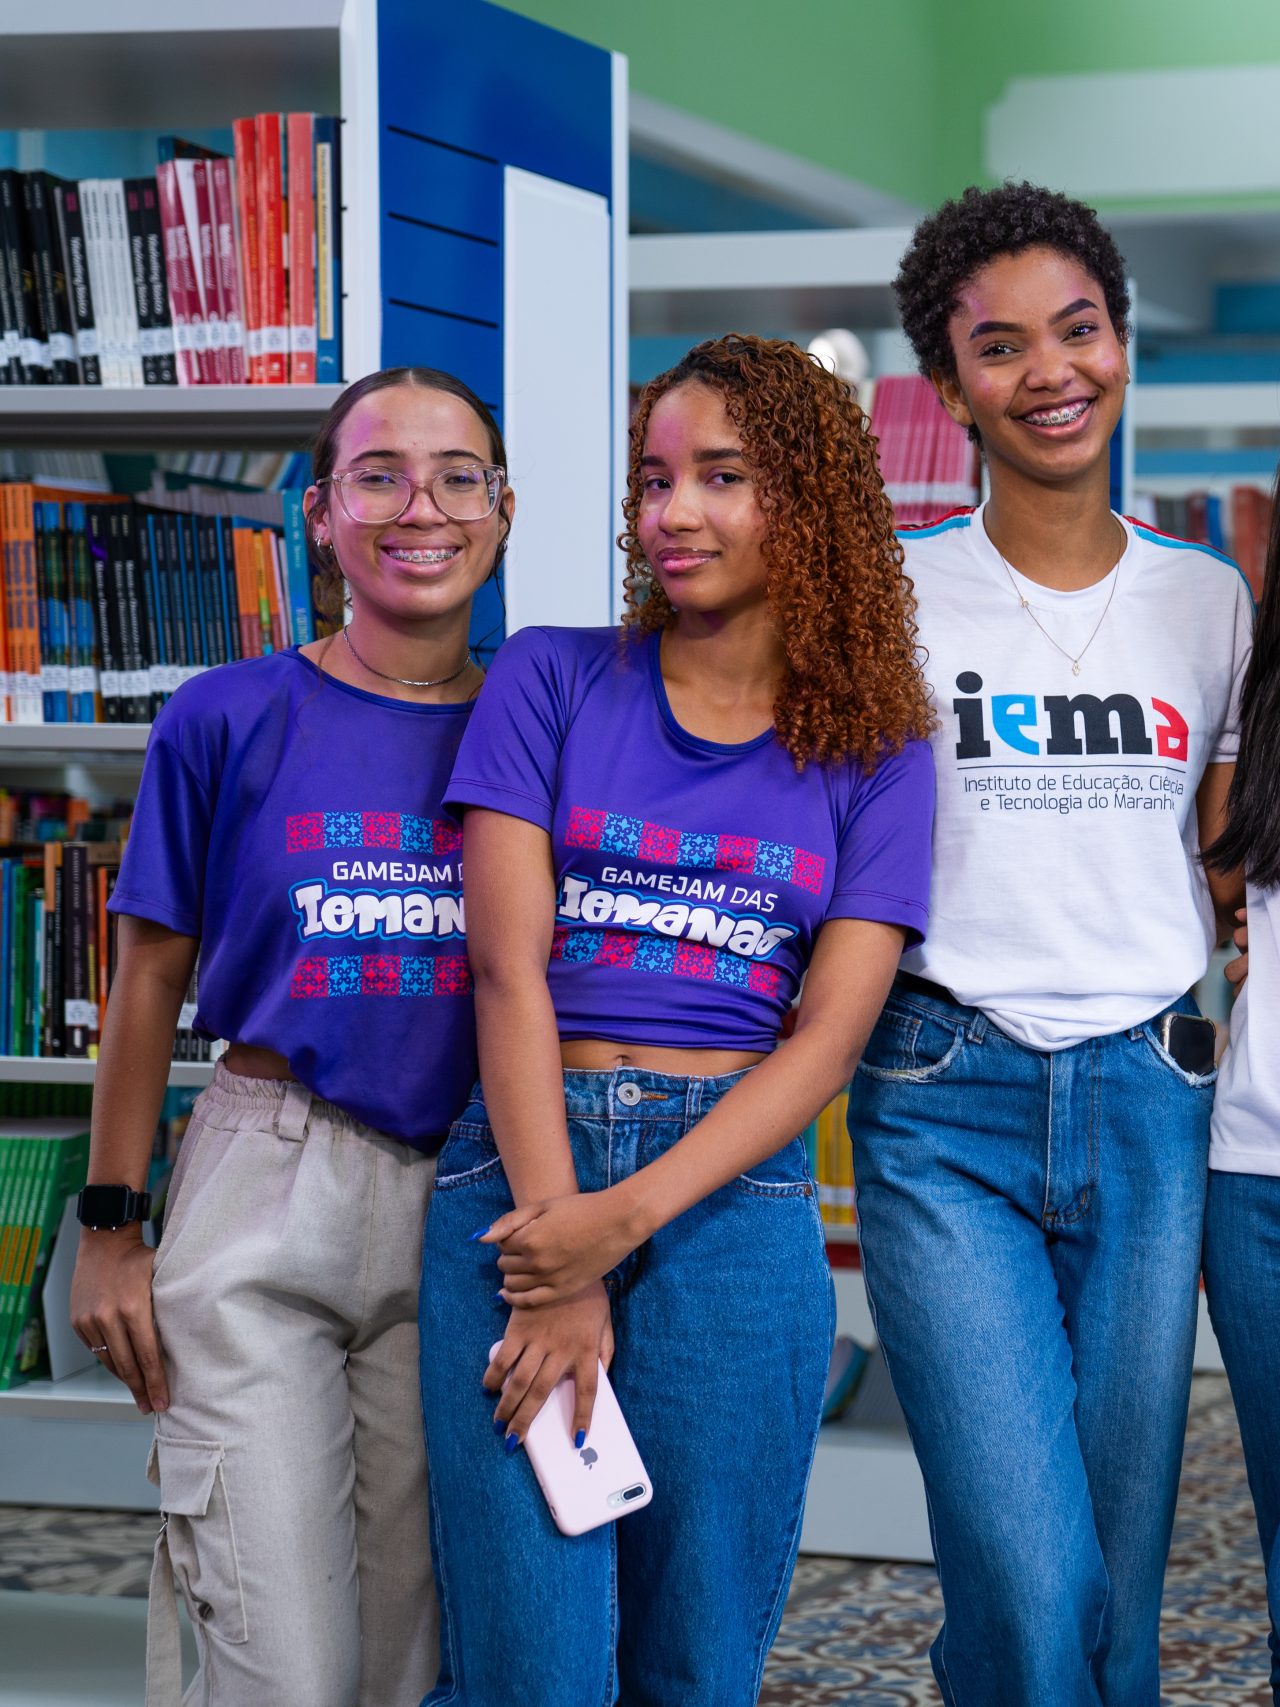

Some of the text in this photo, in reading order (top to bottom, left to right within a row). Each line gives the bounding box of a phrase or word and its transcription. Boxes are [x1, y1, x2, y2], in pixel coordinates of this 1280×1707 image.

[953, 671, 1189, 762] iema
[964, 774, 1184, 796] Instituto de Educação, Ciêcia
[980, 797, 990, 811] e
[996, 793, 1082, 814] Tecnologia
[1088, 793, 1109, 809] do
[333, 861, 452, 883] GAMEJAM
[601, 866, 779, 913] GAMEJAM DAS
